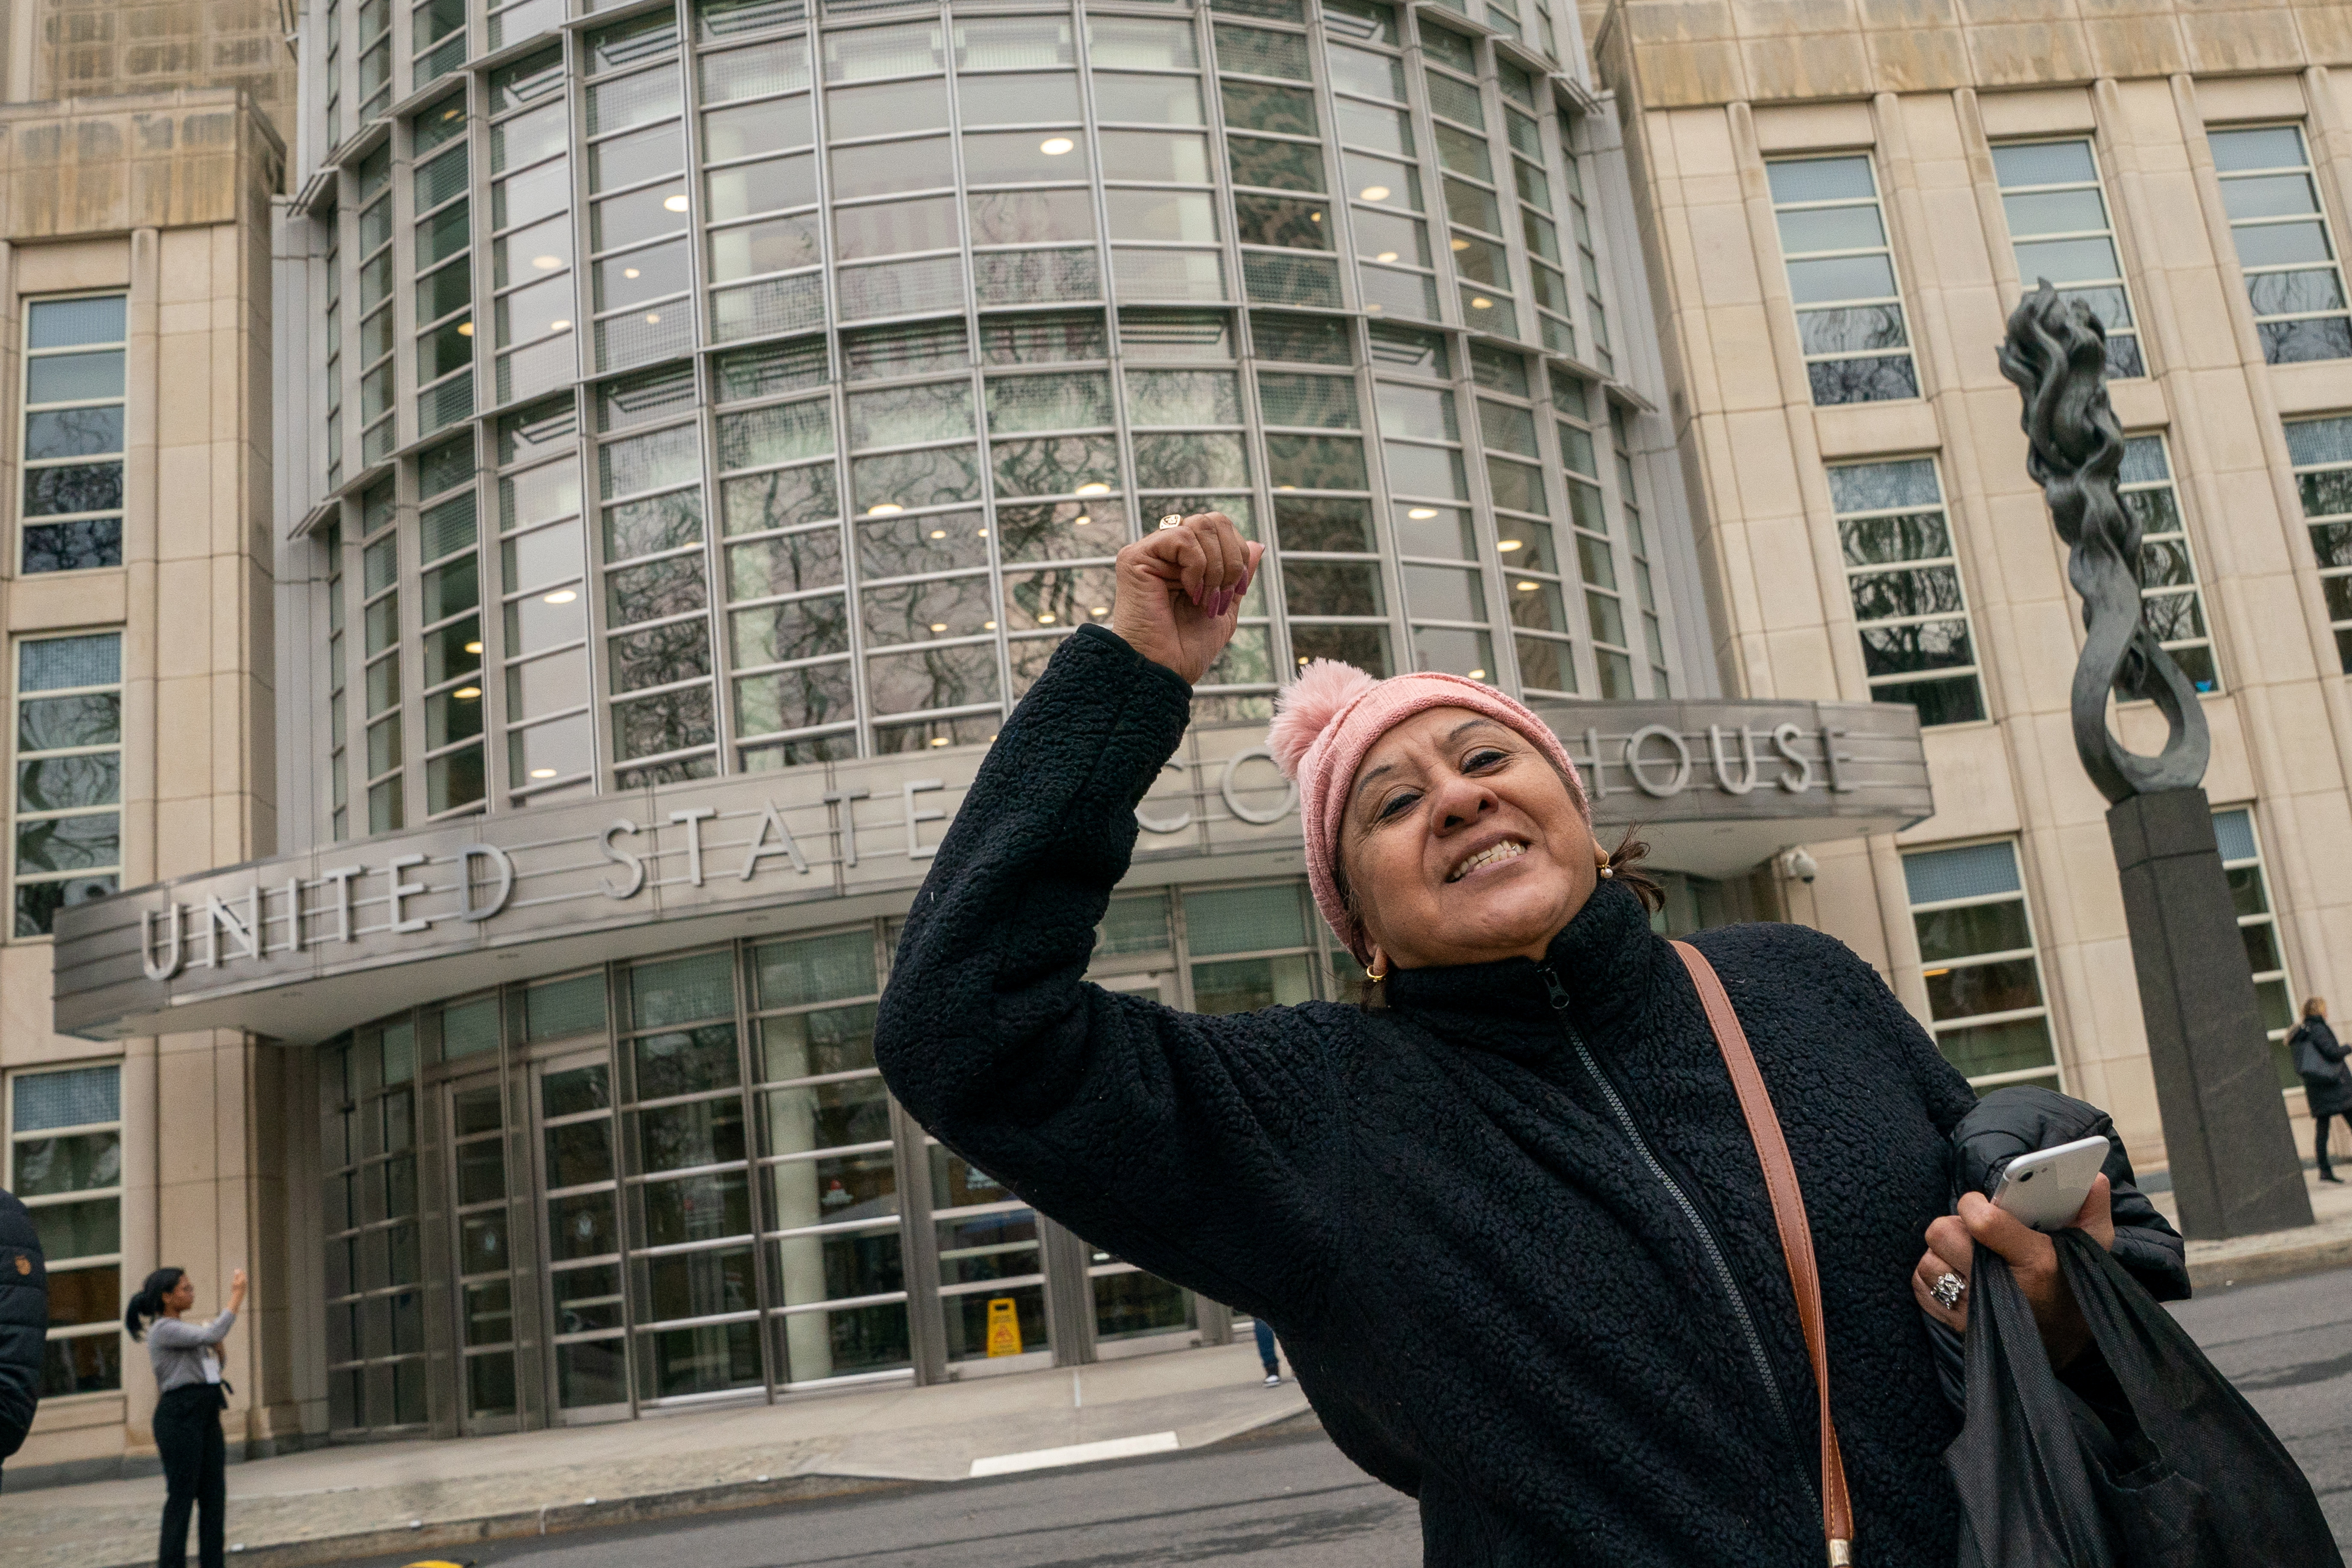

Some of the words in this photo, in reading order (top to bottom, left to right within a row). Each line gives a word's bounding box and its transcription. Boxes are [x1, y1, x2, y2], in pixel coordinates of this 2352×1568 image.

[141, 844, 513, 981] UNITED
[599, 779, 948, 900] STATE
[1135, 723, 1854, 833] COHOUSE
